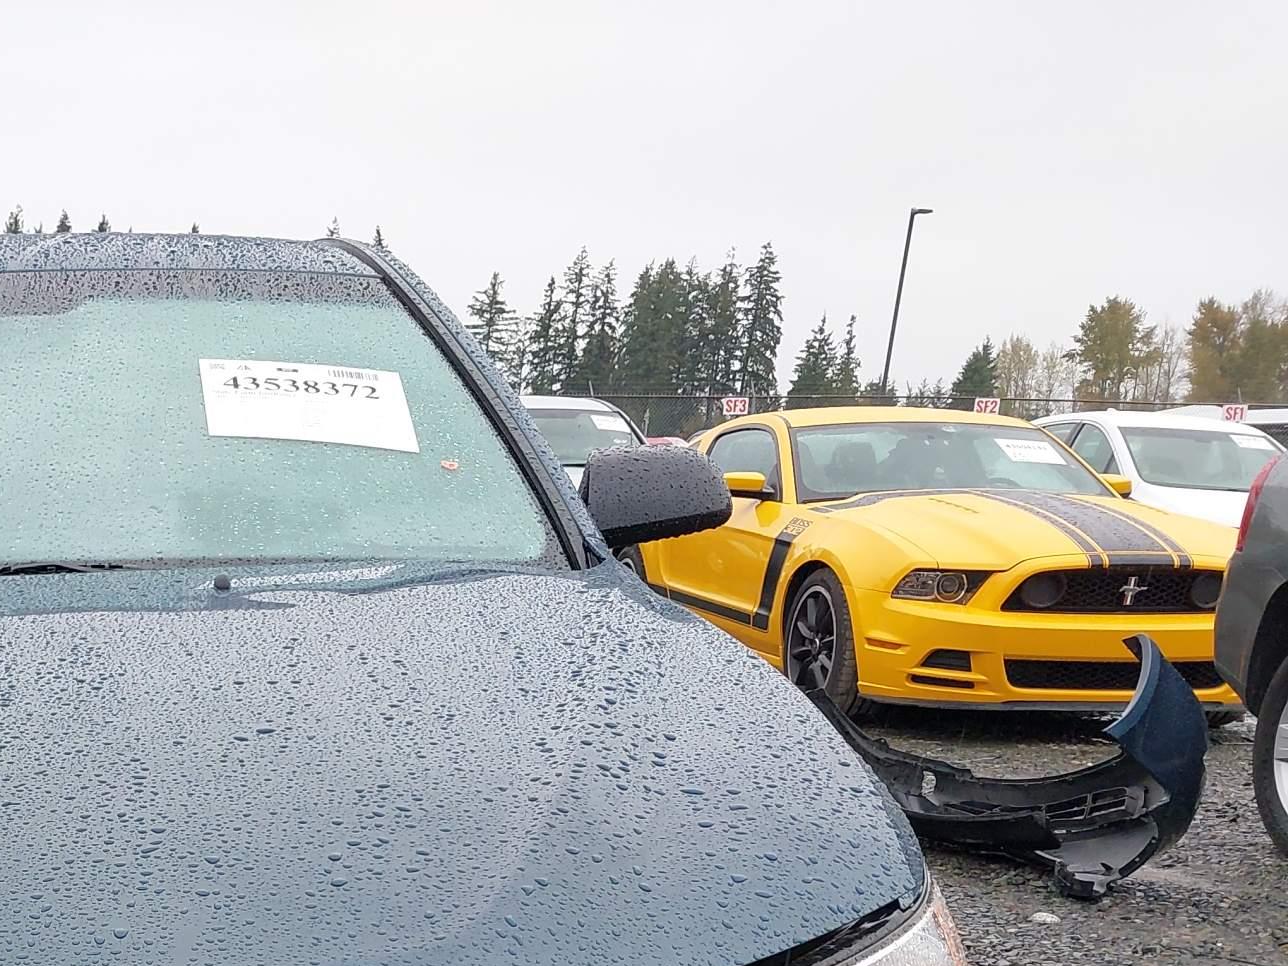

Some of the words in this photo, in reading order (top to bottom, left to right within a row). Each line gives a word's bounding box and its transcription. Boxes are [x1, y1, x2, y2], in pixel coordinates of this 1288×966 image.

[223, 375, 380, 400] 43538372
[725, 399, 747, 413] SF3
[975, 399, 998, 413] SF2
[1225, 406, 1245, 420] SF1
